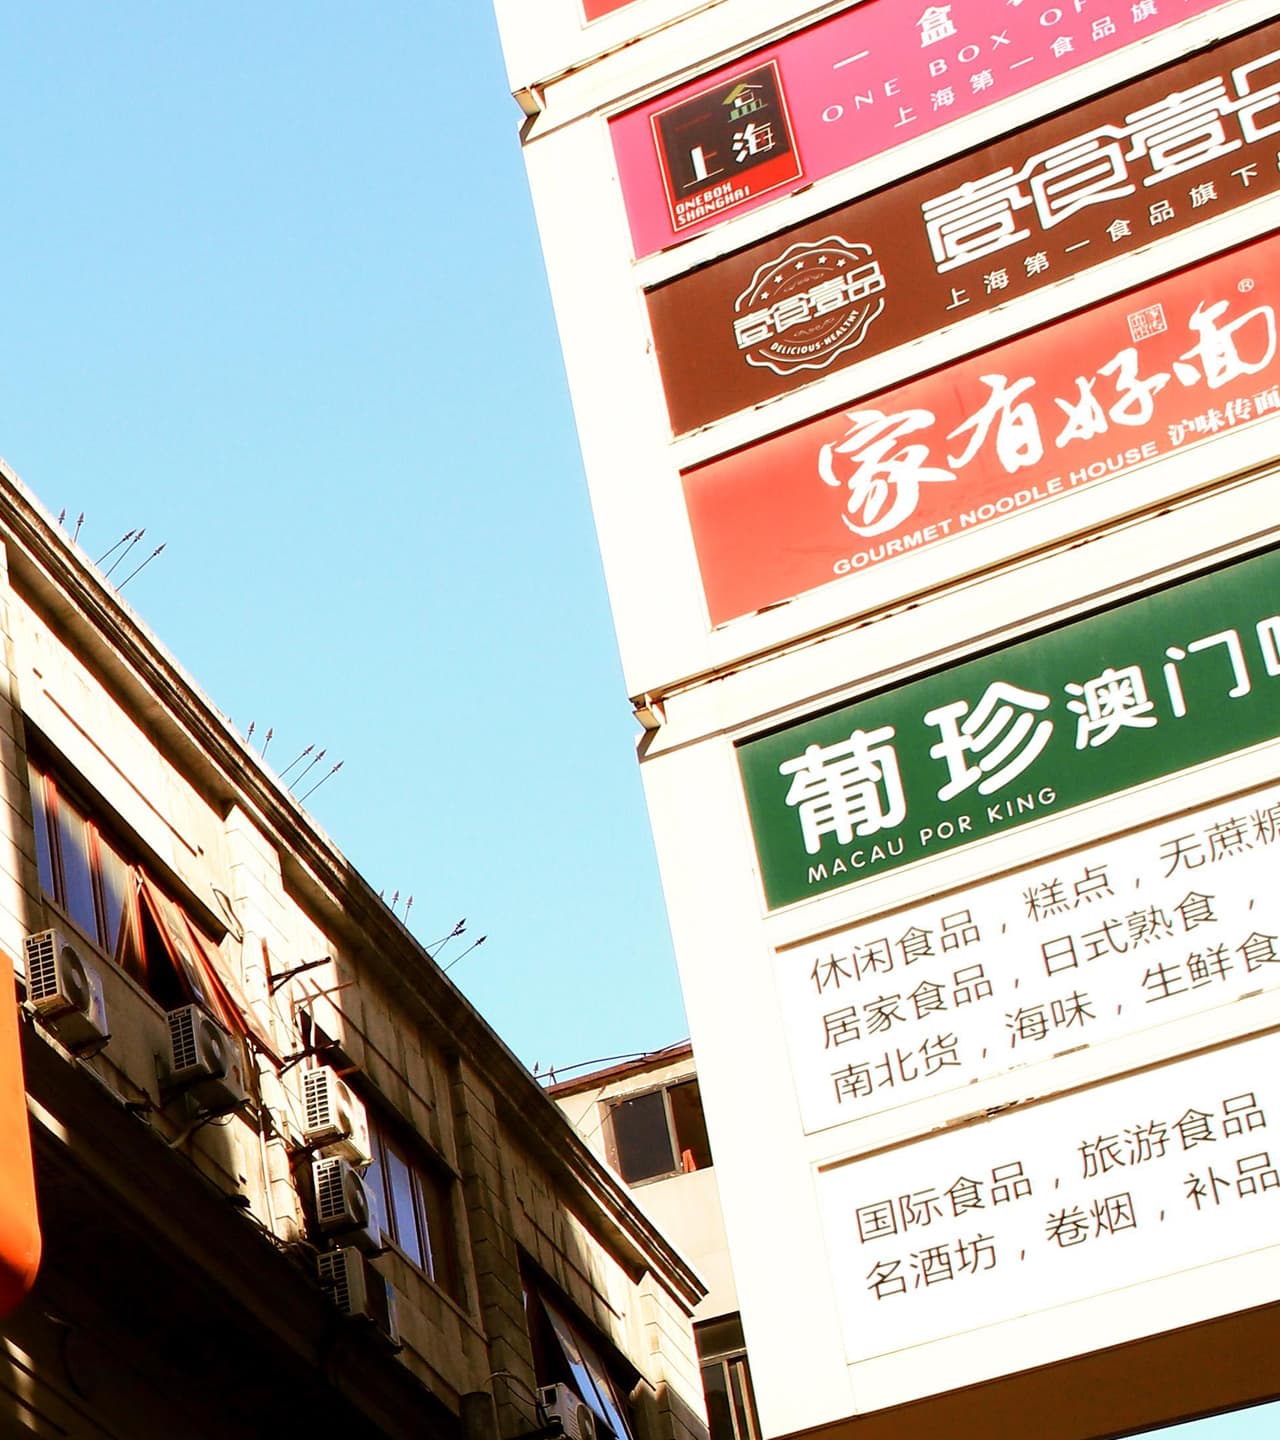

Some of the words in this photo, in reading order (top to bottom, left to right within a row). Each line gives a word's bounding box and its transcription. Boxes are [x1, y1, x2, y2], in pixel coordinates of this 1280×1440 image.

[821, 77, 901, 123] ONE
[928, 30, 1012, 77] BOX
[675, 181, 733, 215] ONEBOX
[678, 187, 751, 227] SHANGHAI
[945, 151, 1280, 311] 上海第一食品旗下
[817, 299, 1278, 538] 家有好面
[833, 518, 952, 575] GOURMET
[959, 476, 1063, 526] NOODLE
[1069, 440, 1159, 493] HOUSE
[808, 836, 905, 884] MACAU
[920, 814, 972, 847] POR
[987, 787, 1058, 825] KING
